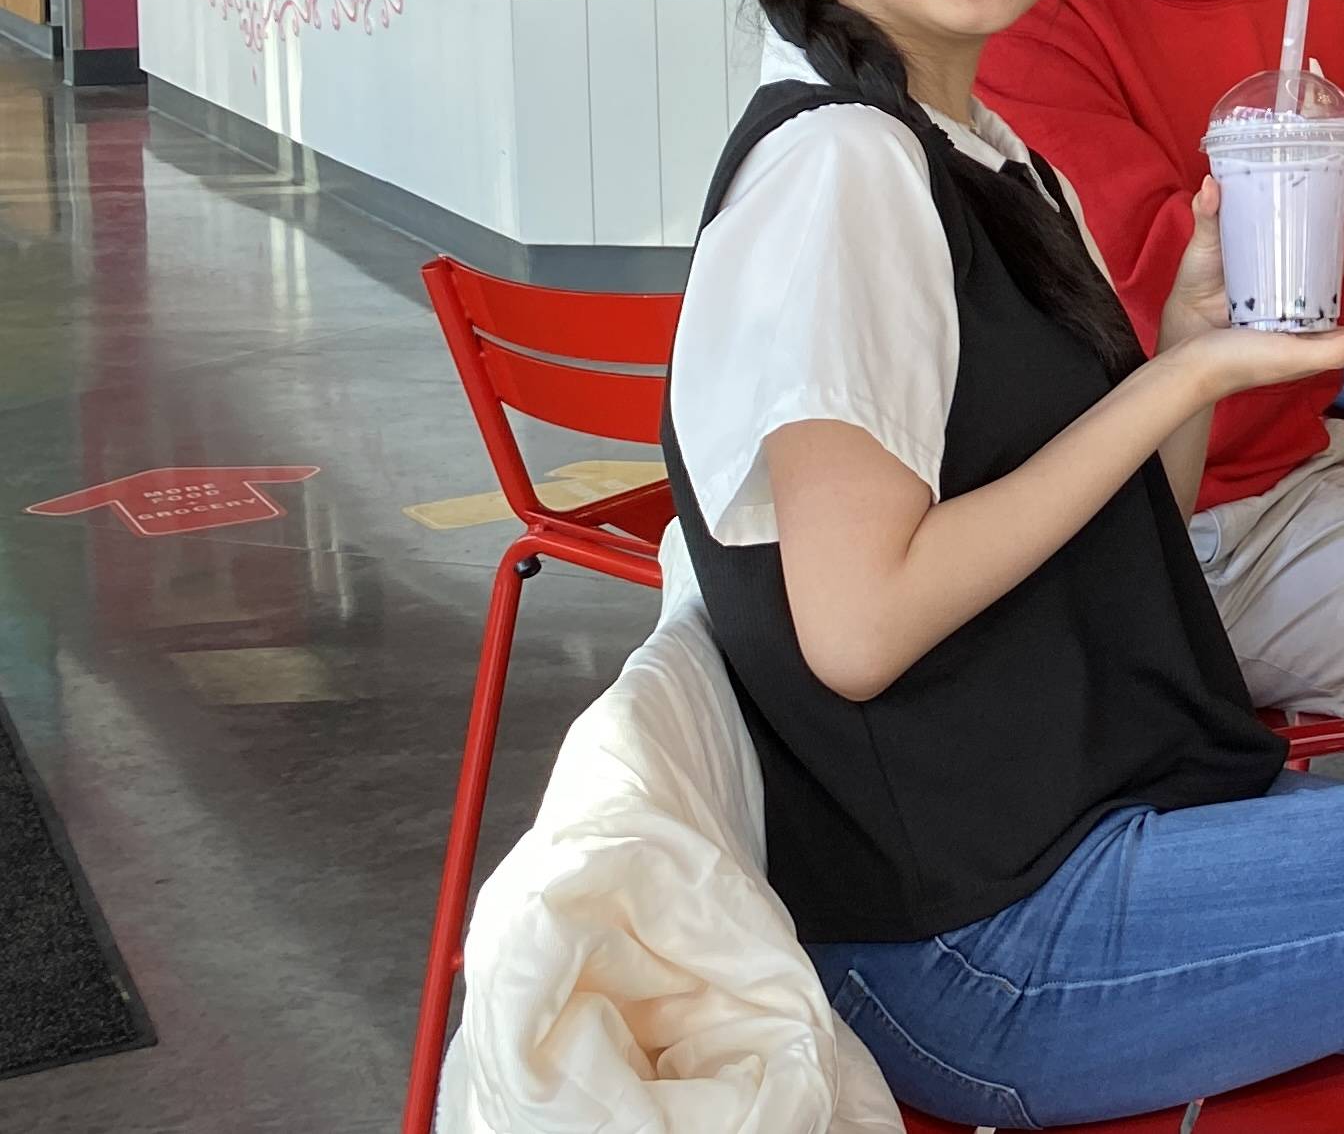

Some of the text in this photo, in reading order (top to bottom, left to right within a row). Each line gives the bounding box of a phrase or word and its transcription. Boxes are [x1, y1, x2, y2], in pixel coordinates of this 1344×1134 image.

[143, 482, 217, 499] MORE
[151, 488, 220, 505] FOOD
[136, 496, 257, 521] GROCERY
